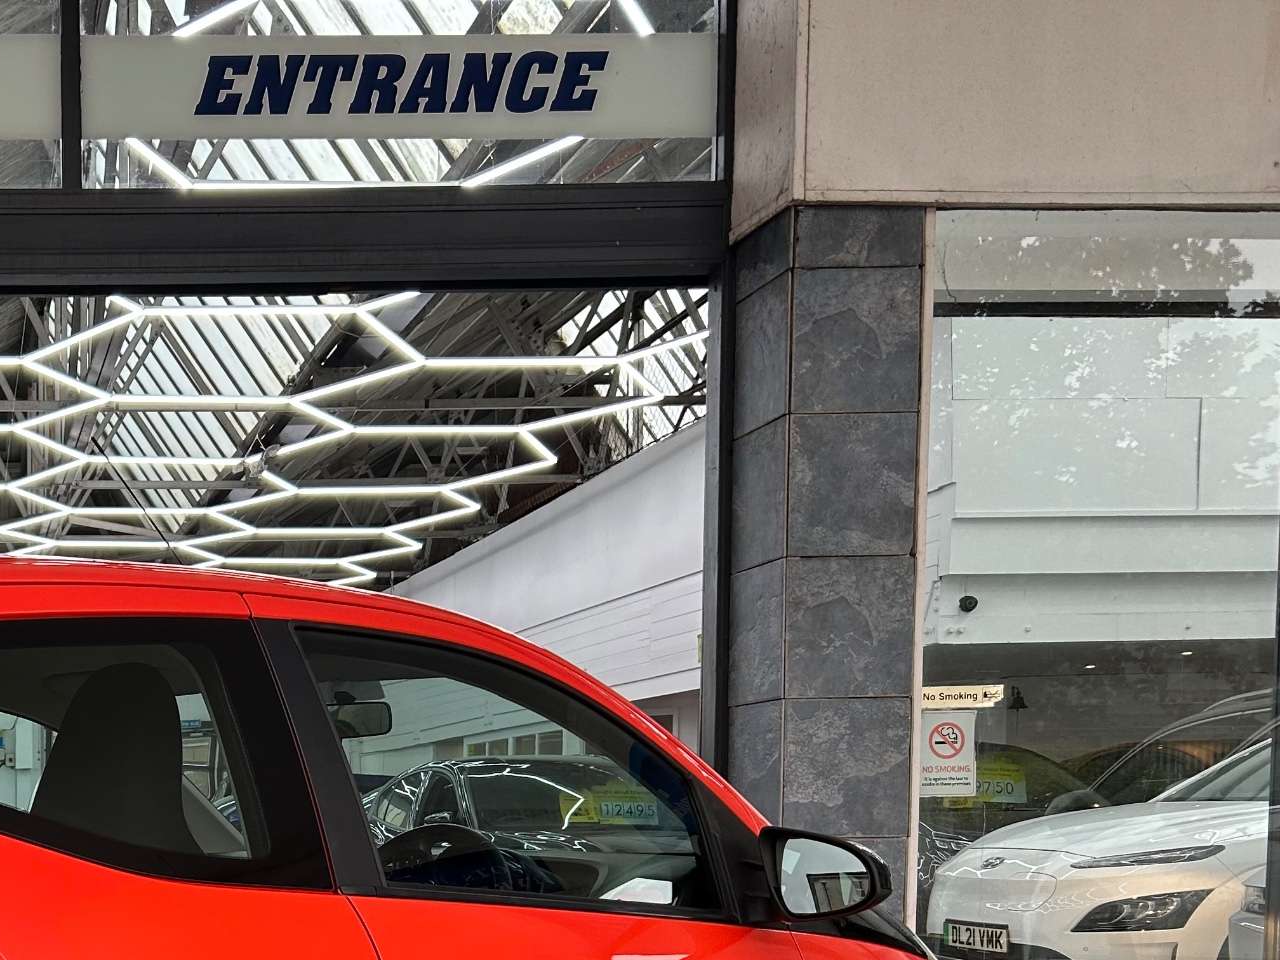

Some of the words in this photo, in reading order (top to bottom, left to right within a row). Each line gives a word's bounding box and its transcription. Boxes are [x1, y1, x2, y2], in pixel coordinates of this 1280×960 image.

[193, 50, 609, 115] ENTRANCE
[923, 692, 936, 701] No
[939, 691, 978, 702] Smoking
[922, 765, 934, 774] NO
[602, 803, 656, 817] 12495
[951, 925, 976, 947] DL21
[978, 928, 1003, 950] VMK
